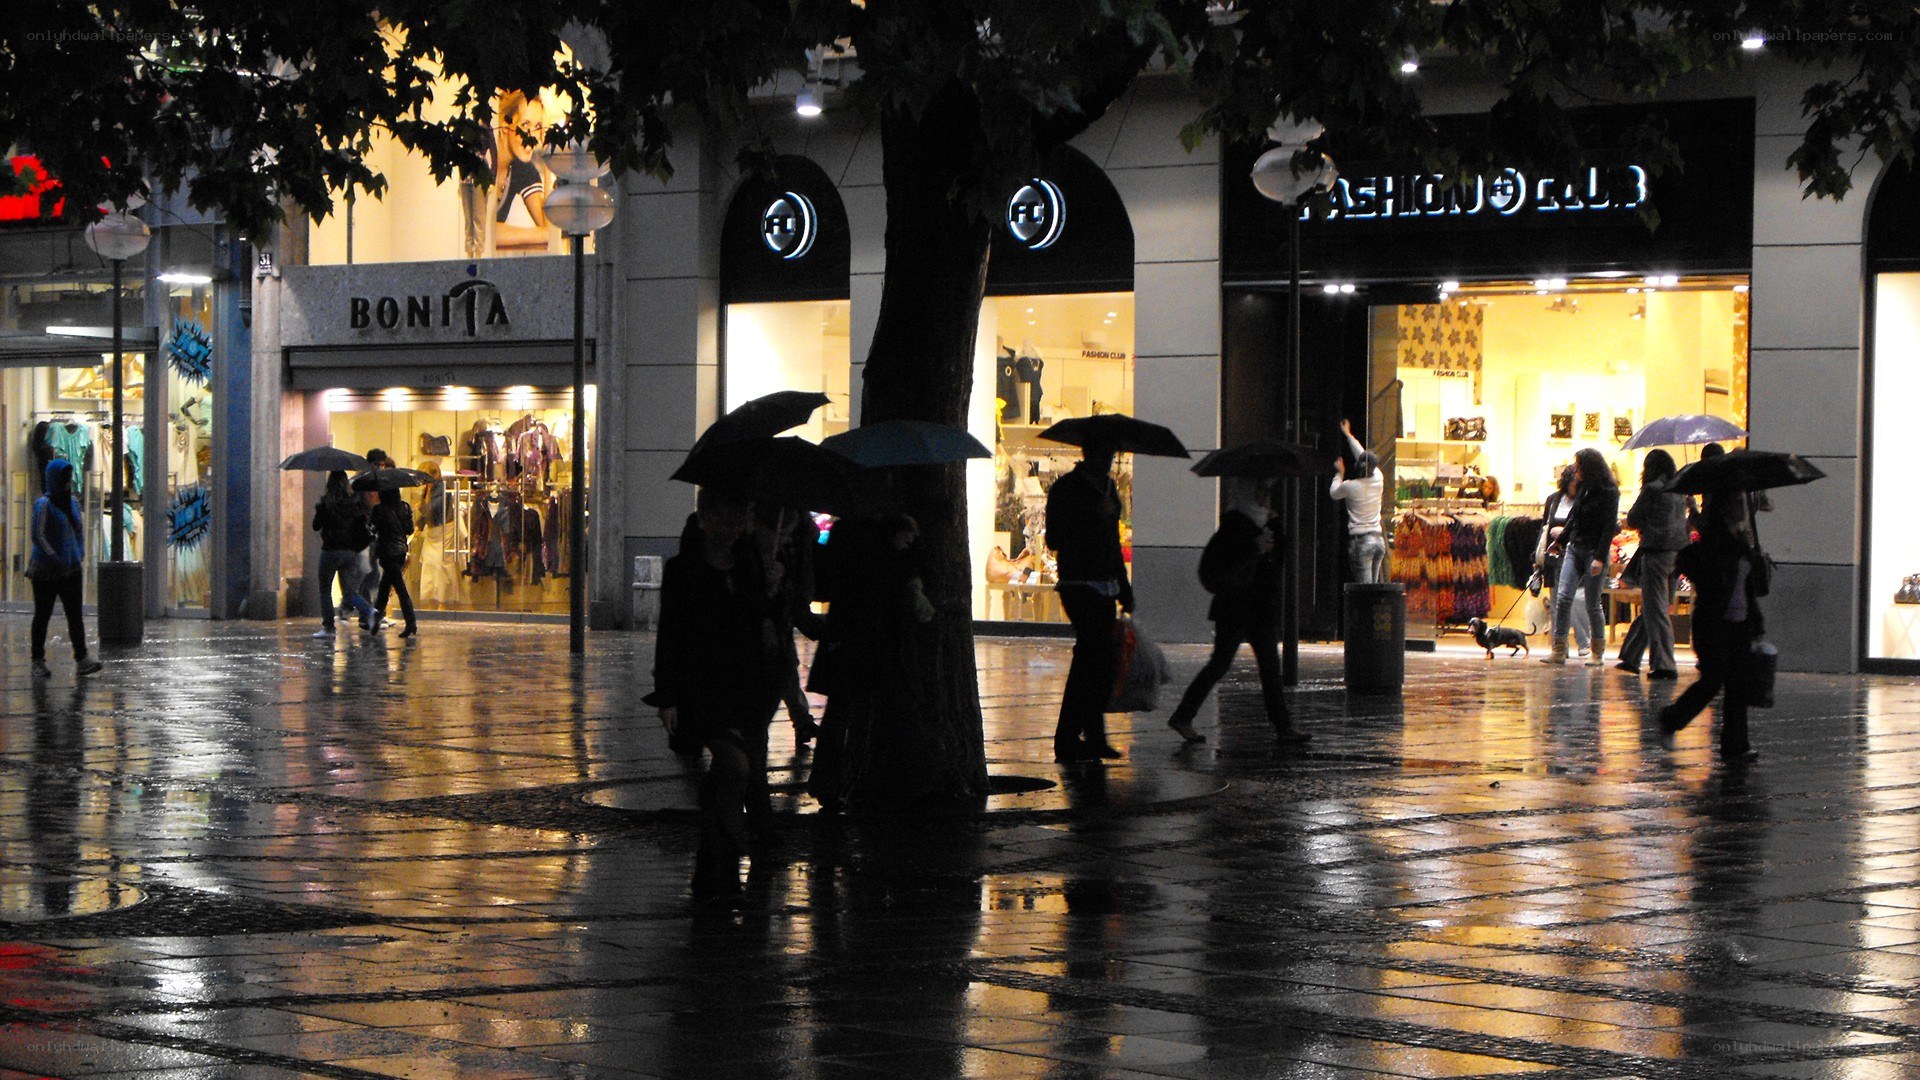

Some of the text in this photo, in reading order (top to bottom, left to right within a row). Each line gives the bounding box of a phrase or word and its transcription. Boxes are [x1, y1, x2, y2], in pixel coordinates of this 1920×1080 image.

[259, 253, 271, 265] 31
[351, 280, 509, 336] BONITA
[1081, 350, 1126, 360] FASHION CLUB
